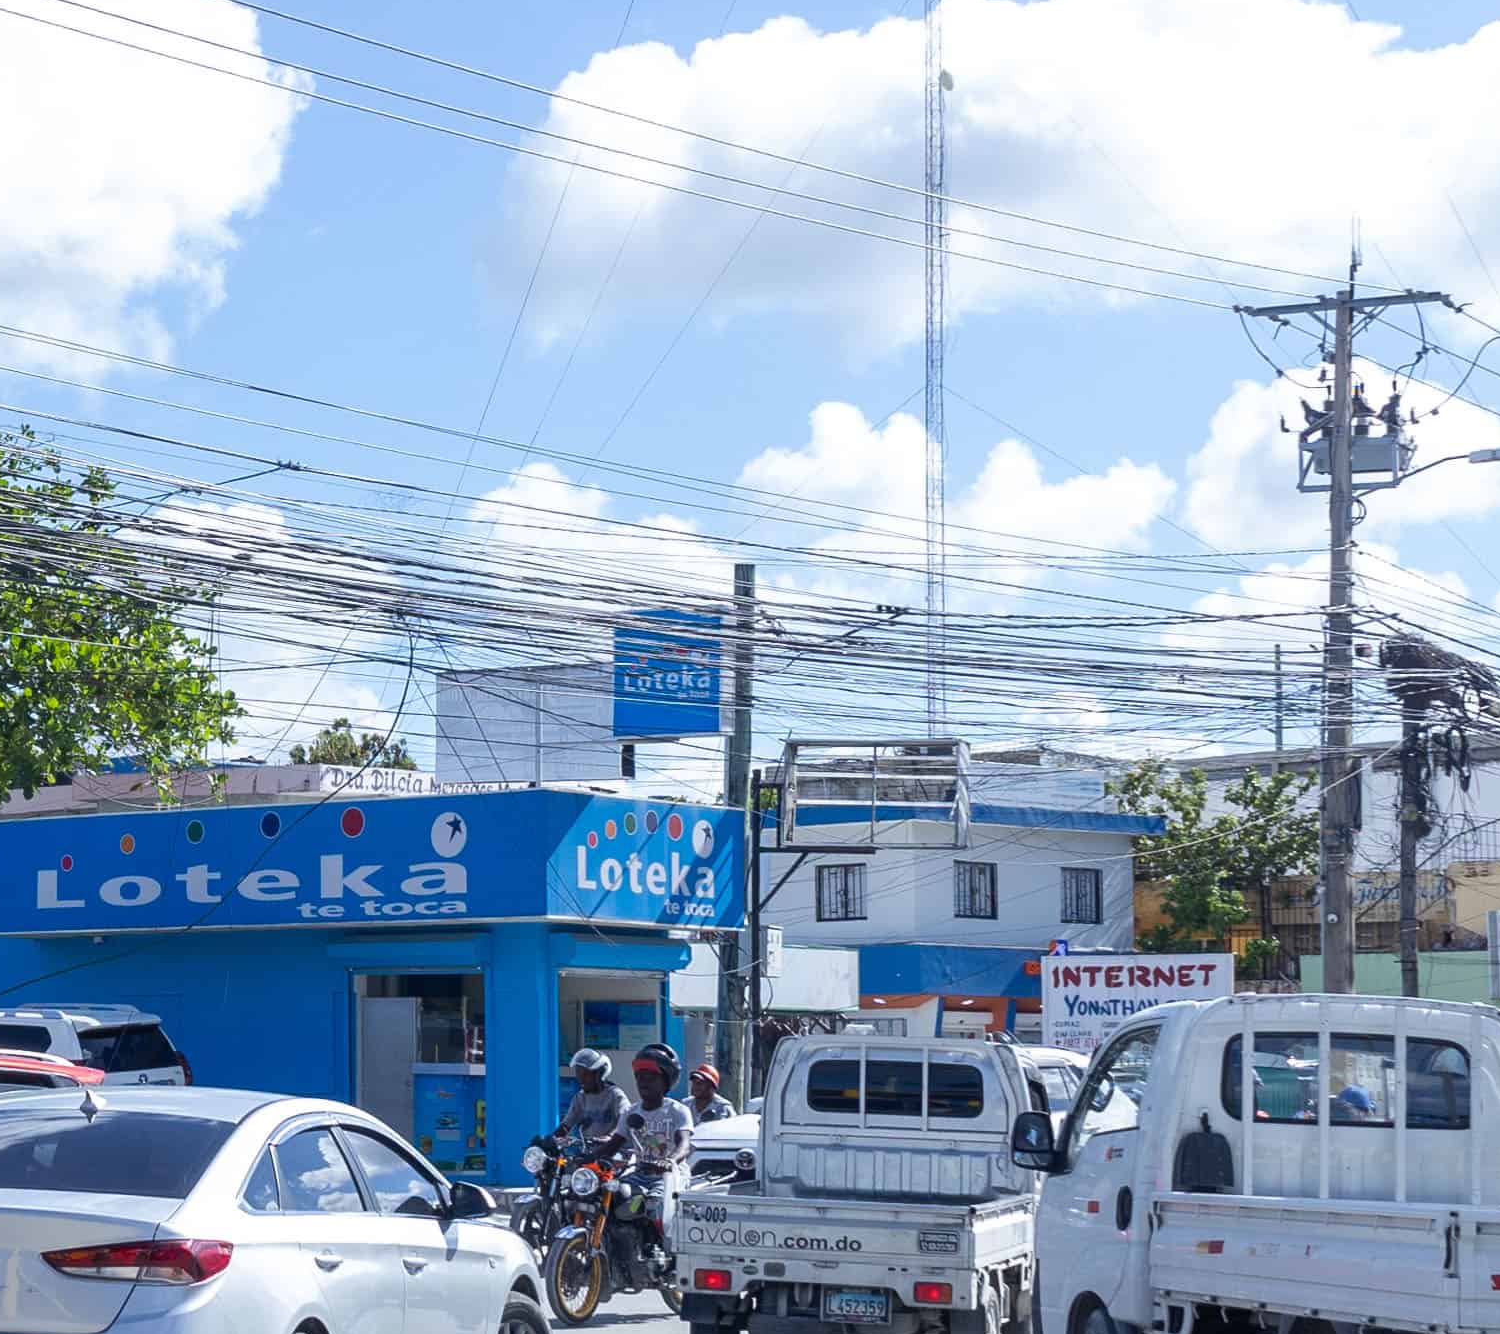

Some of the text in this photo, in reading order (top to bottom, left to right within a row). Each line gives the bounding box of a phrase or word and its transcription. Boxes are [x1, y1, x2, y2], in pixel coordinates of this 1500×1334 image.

[37, 854, 468, 909] Loteka
[577, 845, 715, 898] Loteka
[297, 899, 467, 918] te toca
[664, 898, 715, 916] te toca
[1052, 964, 1217, 988] INTERNET
